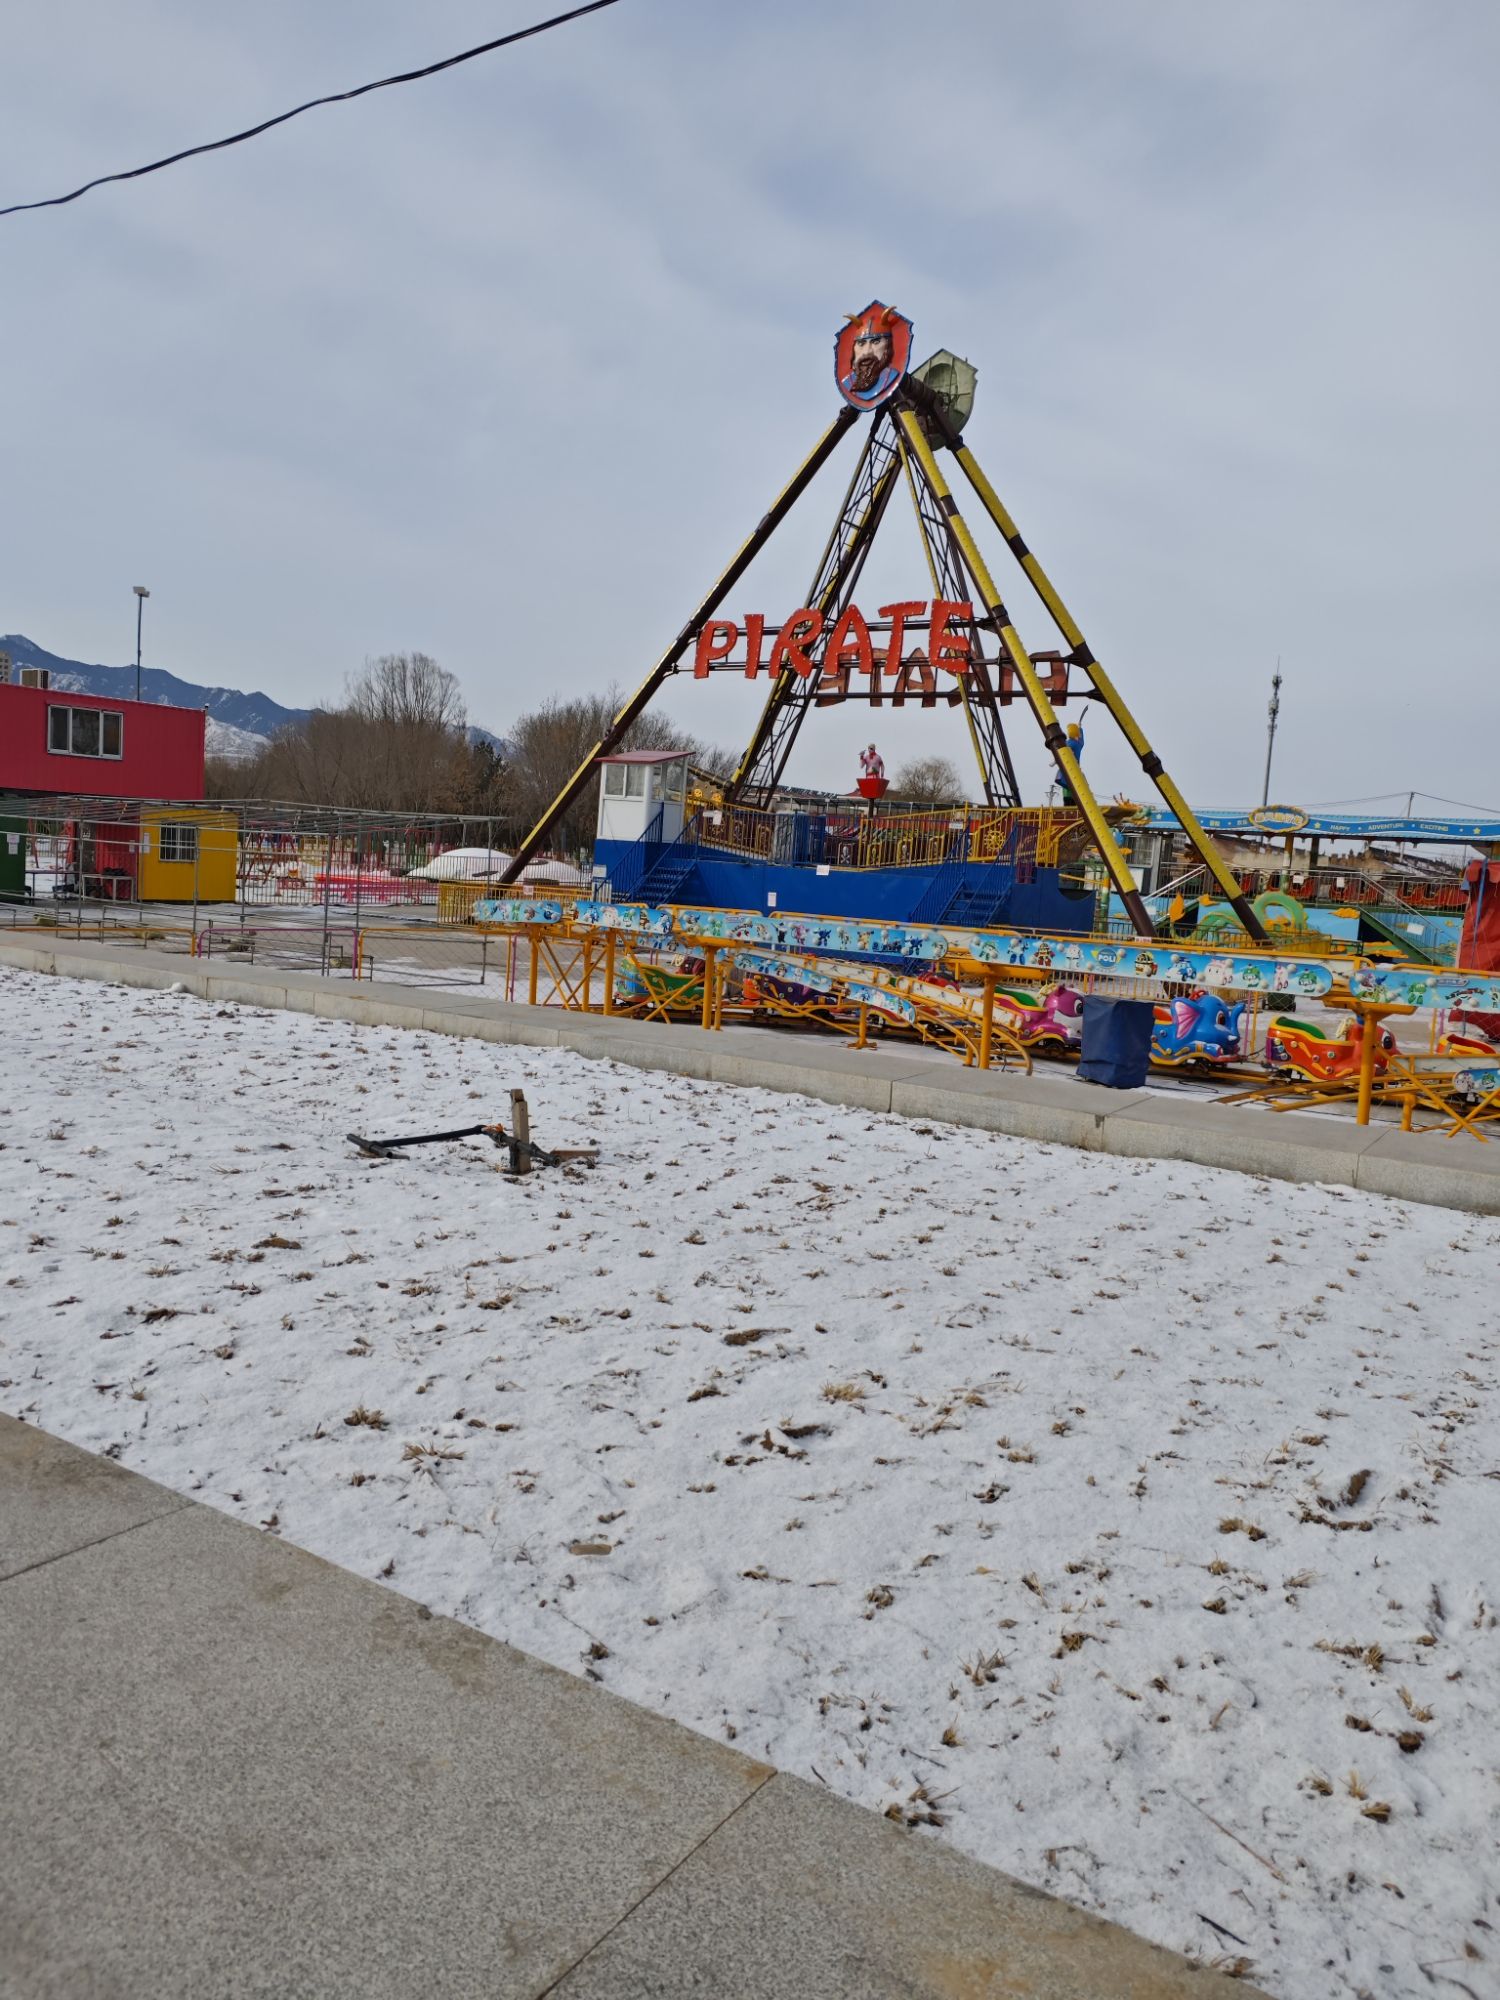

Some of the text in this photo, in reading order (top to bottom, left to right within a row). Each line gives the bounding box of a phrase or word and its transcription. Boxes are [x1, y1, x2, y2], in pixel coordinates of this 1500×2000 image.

[694, 598, 973, 679] PIRATE
[1330, 824, 1351, 832] HAPPY
[1368, 822, 1405, 831] ADVENTURE
[1098, 954, 1116, 963] POLI
